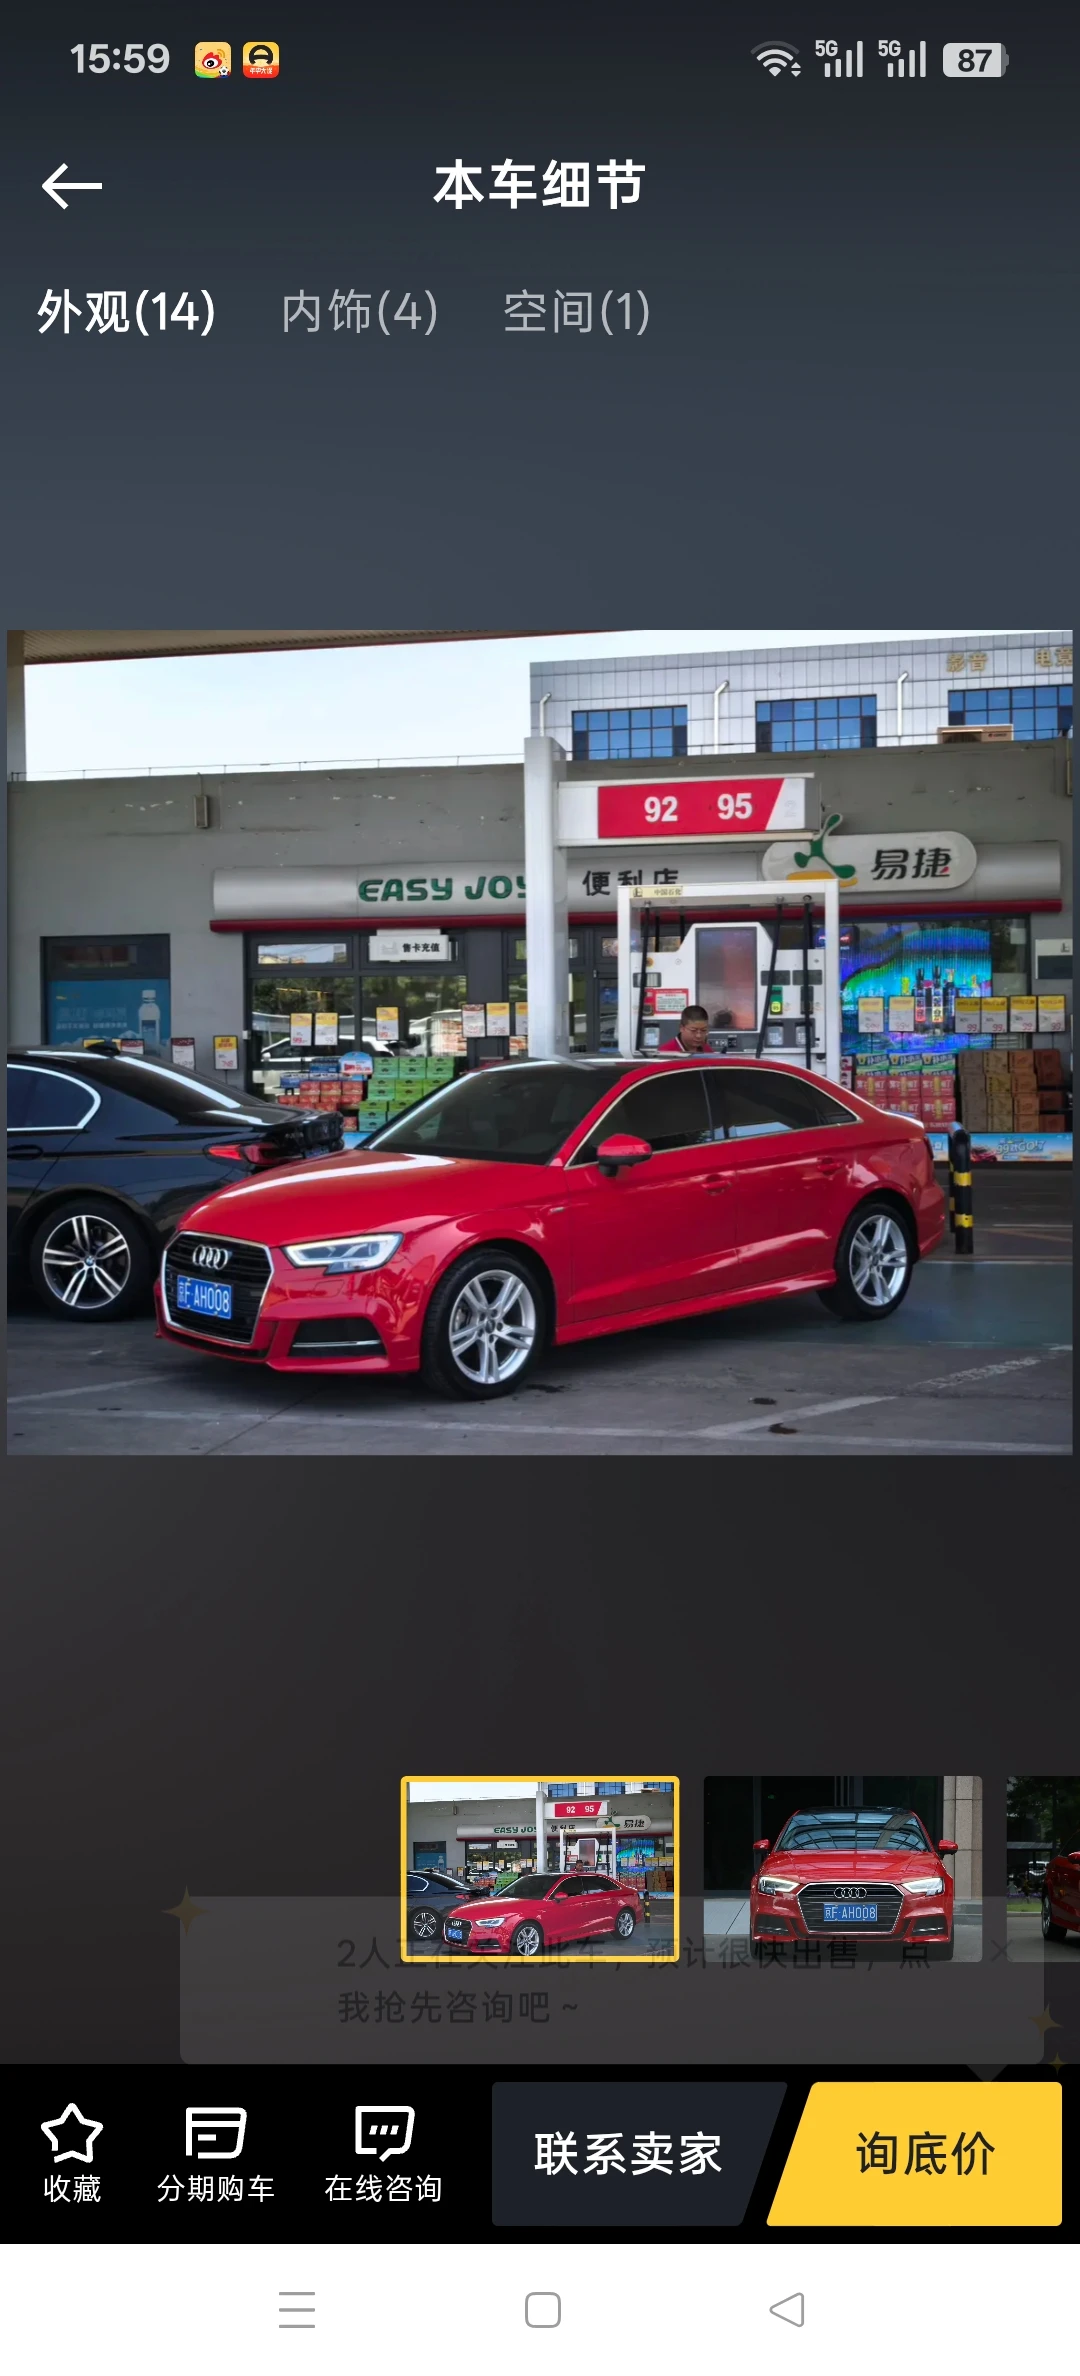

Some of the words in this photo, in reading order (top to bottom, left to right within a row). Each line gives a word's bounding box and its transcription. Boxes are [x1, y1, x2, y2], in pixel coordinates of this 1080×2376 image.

[70, 42, 171, 74] 15:59
[815, 39, 838, 57] 5G
[878, 39, 901, 57] 5G
[957, 48, 993, 73] 87
[432, 157, 646, 210] 本车细节
[36, 288, 215, 337] 外观(14)
[283, 288, 437, 336] 内饰(4)
[503, 288, 650, 336] 空间(1)
[947, 652, 988, 671] 影音
[644, 796, 679, 822] 92
[717, 793, 753, 820] 95
[870, 847, 952, 880] 易捷
[358, 878, 453, 902] EASY
[402, 942, 440, 953] 售卡充值
[566, 1805, 576, 1814] 92
[584, 1804, 595, 1813] 95
[533, 2130, 723, 2176] 联系卖家
[855, 2130, 996, 2176] 询底价
[43, 2173, 102, 2204] 收藏
[156, 2173, 275, 2203] 分期购车
[324, 2173, 442, 2203] 在线咨询
